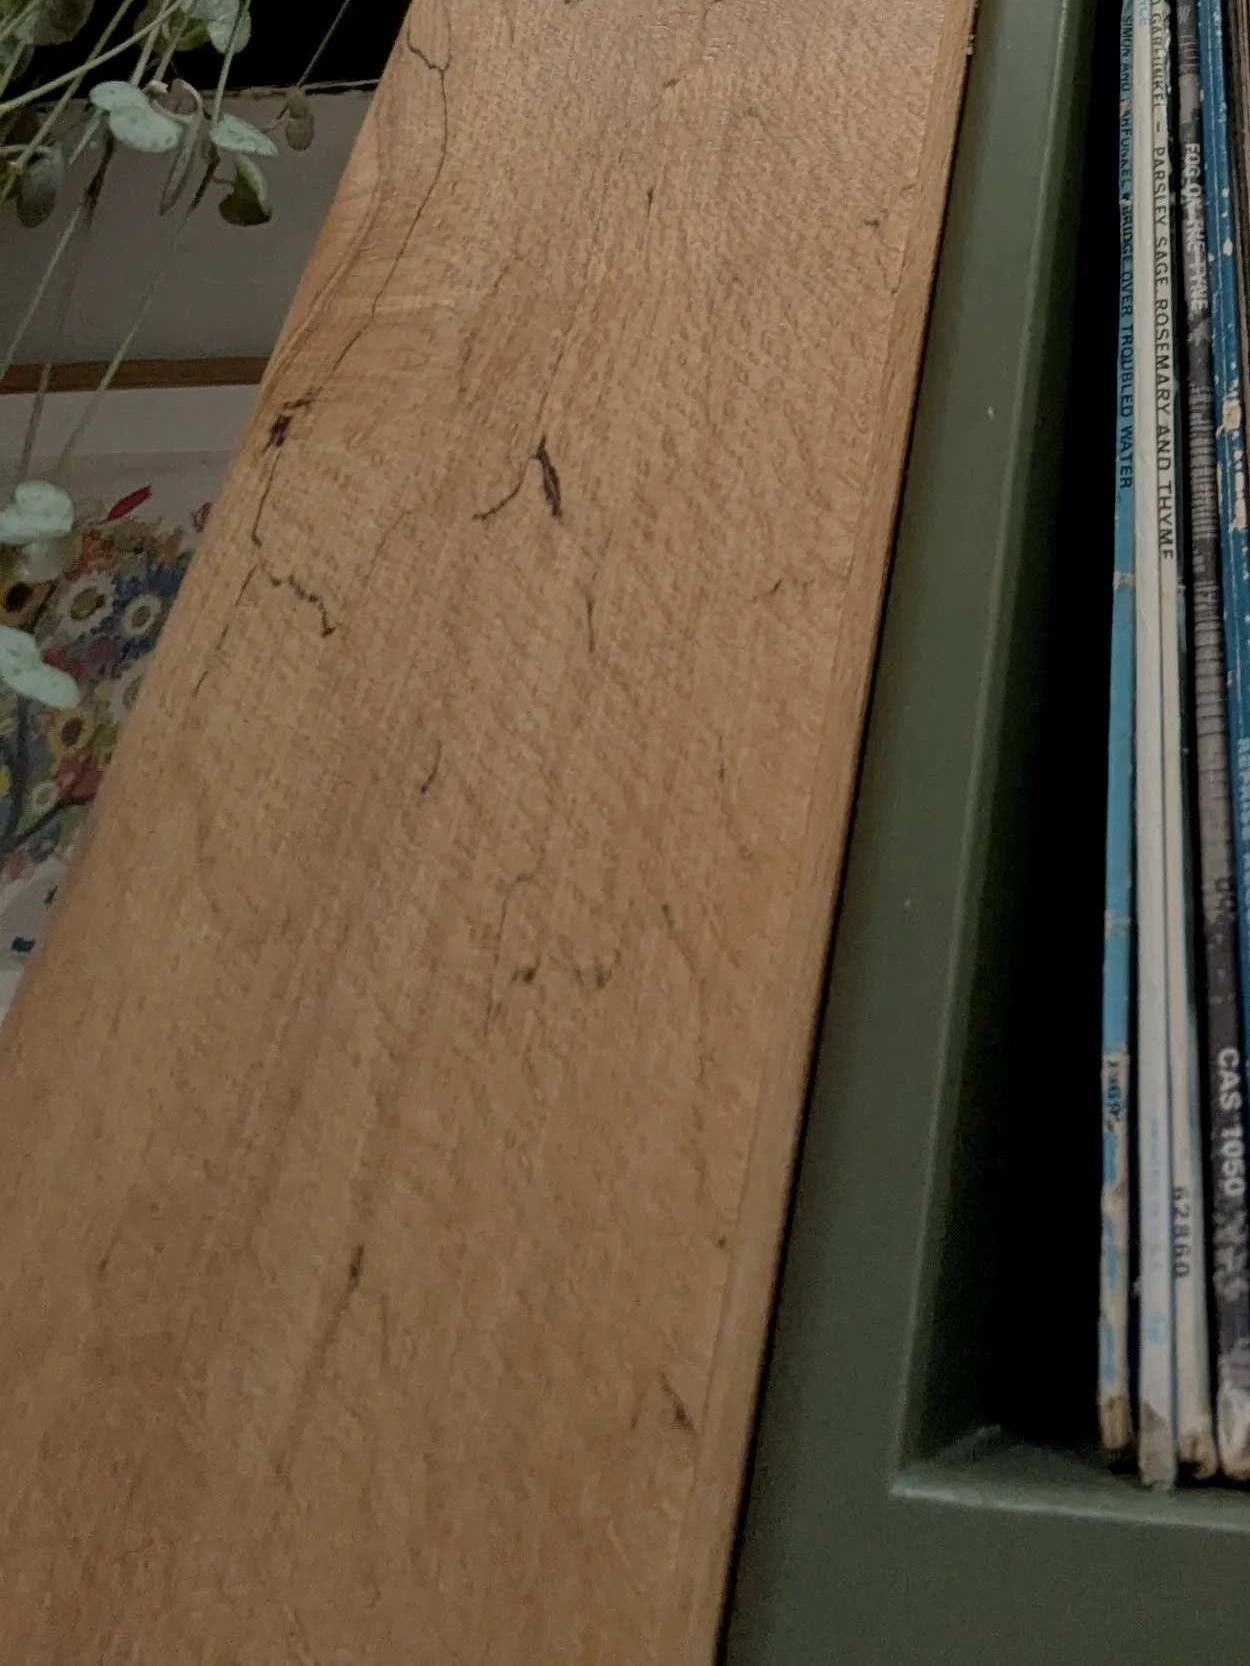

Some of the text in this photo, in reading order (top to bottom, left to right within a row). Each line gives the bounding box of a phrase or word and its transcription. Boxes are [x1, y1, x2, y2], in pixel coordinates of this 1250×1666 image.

[1120, 15, 1134, 57] SIMON
[1150, 13, 1163, 111] GARFUNKEL
[1121, 62, 1134, 92] AND
[1153, 146, 1167, 226] PARSLEY
[1184, 141, 1201, 177] FOG
[1120, 205, 1134, 265] BRIDGE
[1120, 271, 1134, 316] OVER
[1119, 323, 1134, 417] TROUBLED
[1155, 298, 1171, 414] ROSEMARY
[1119, 425, 1133, 489] WATER
[1157, 424, 1172, 472] AND
[1158, 480, 1174, 561] THYME
[1217, 1047, 1247, 1197] CAS 1050
